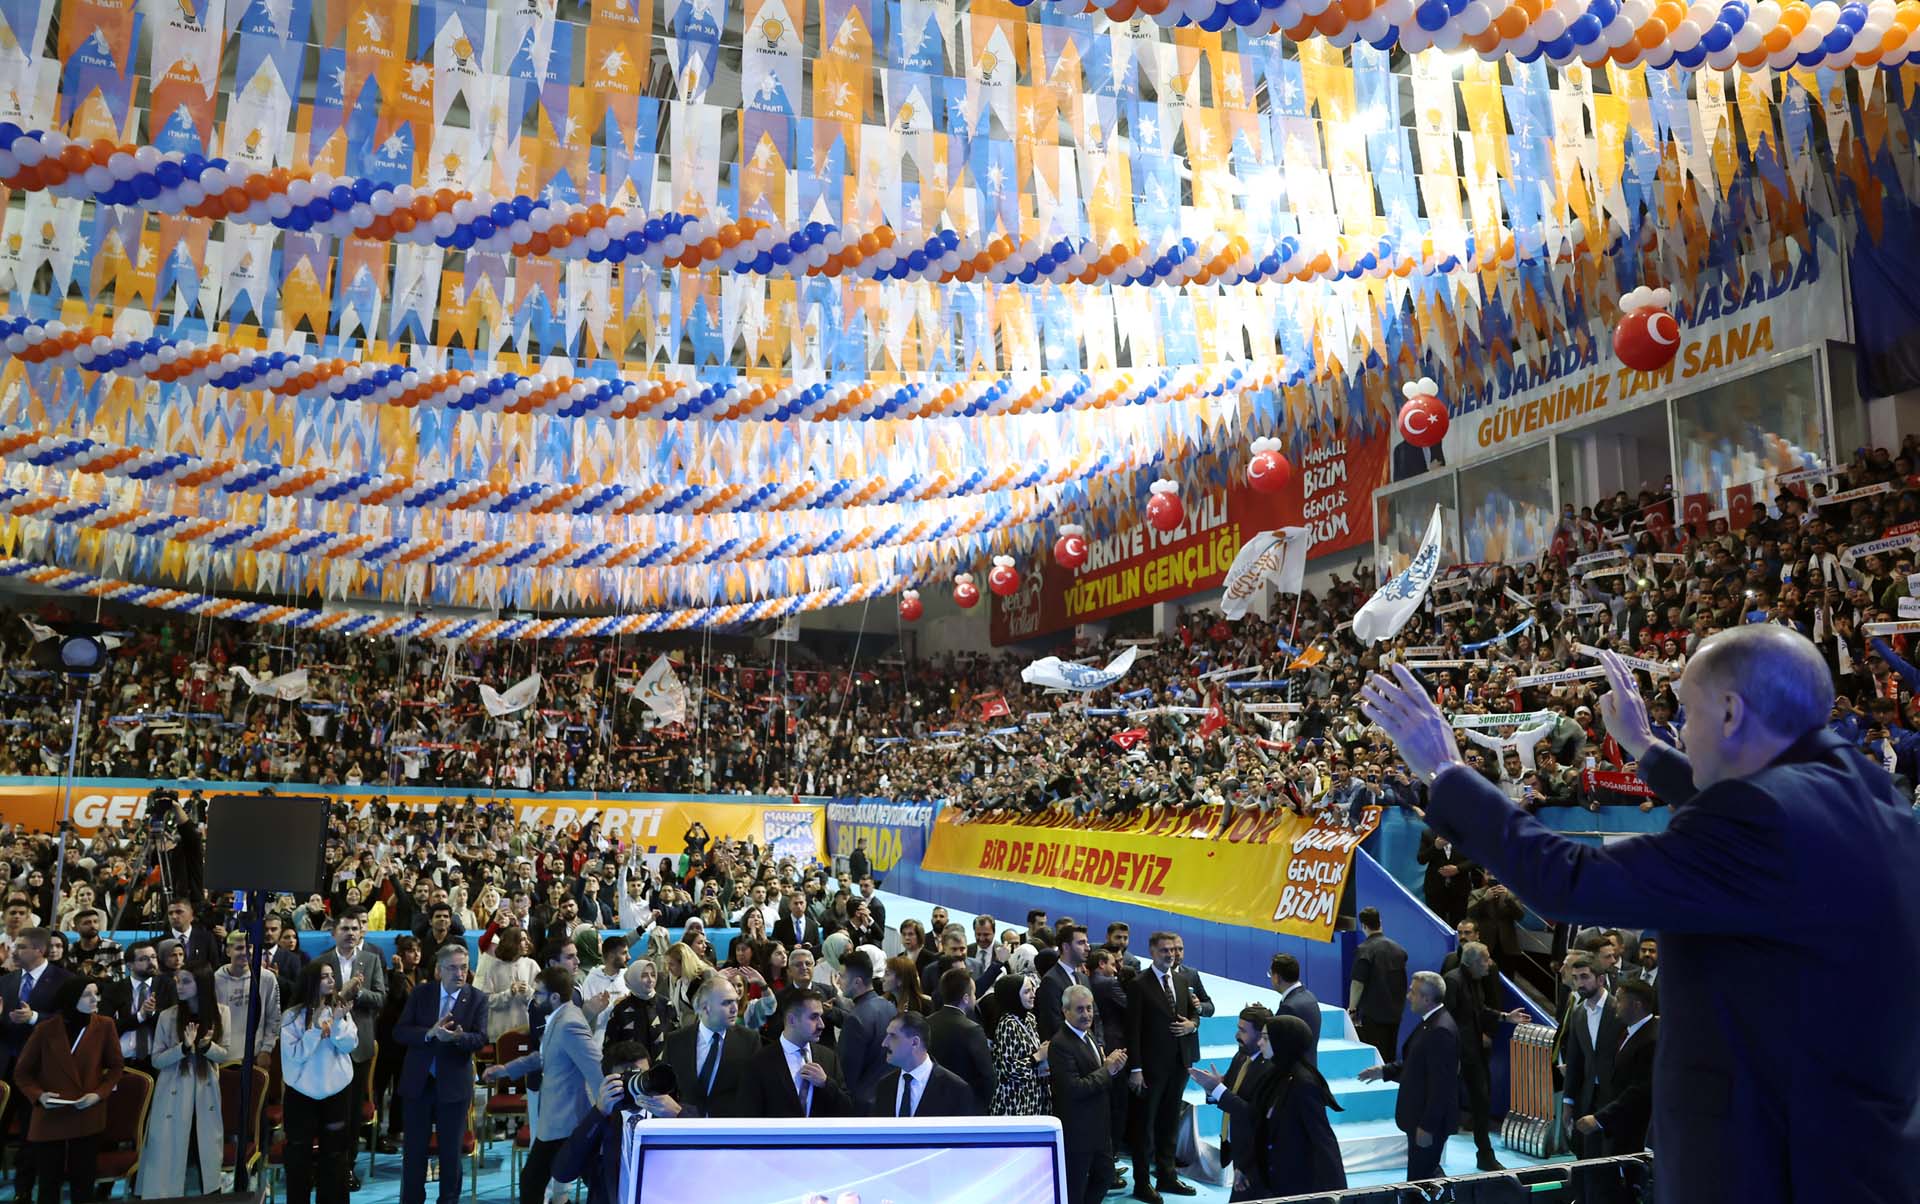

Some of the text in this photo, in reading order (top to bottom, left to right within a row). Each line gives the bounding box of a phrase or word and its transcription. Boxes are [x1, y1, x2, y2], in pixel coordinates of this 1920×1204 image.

[1477, 316, 1774, 448] GÜVENİMİZ TAM SANA
[1303, 459, 1348, 499] BİZİM
[1304, 512, 1350, 552] BİZİM
[1852, 535, 1913, 556] AK GENÇLİK
[1064, 523, 1241, 617] YÜZYILIN GENÇLİĞİ
[1292, 828, 1361, 854] BİZİM
[978, 839, 1173, 896] BİR DE DİLLERDEYİZ
[1287, 858, 1345, 888] GENÇLİK
[1273, 885, 1336, 925] BİZİM
